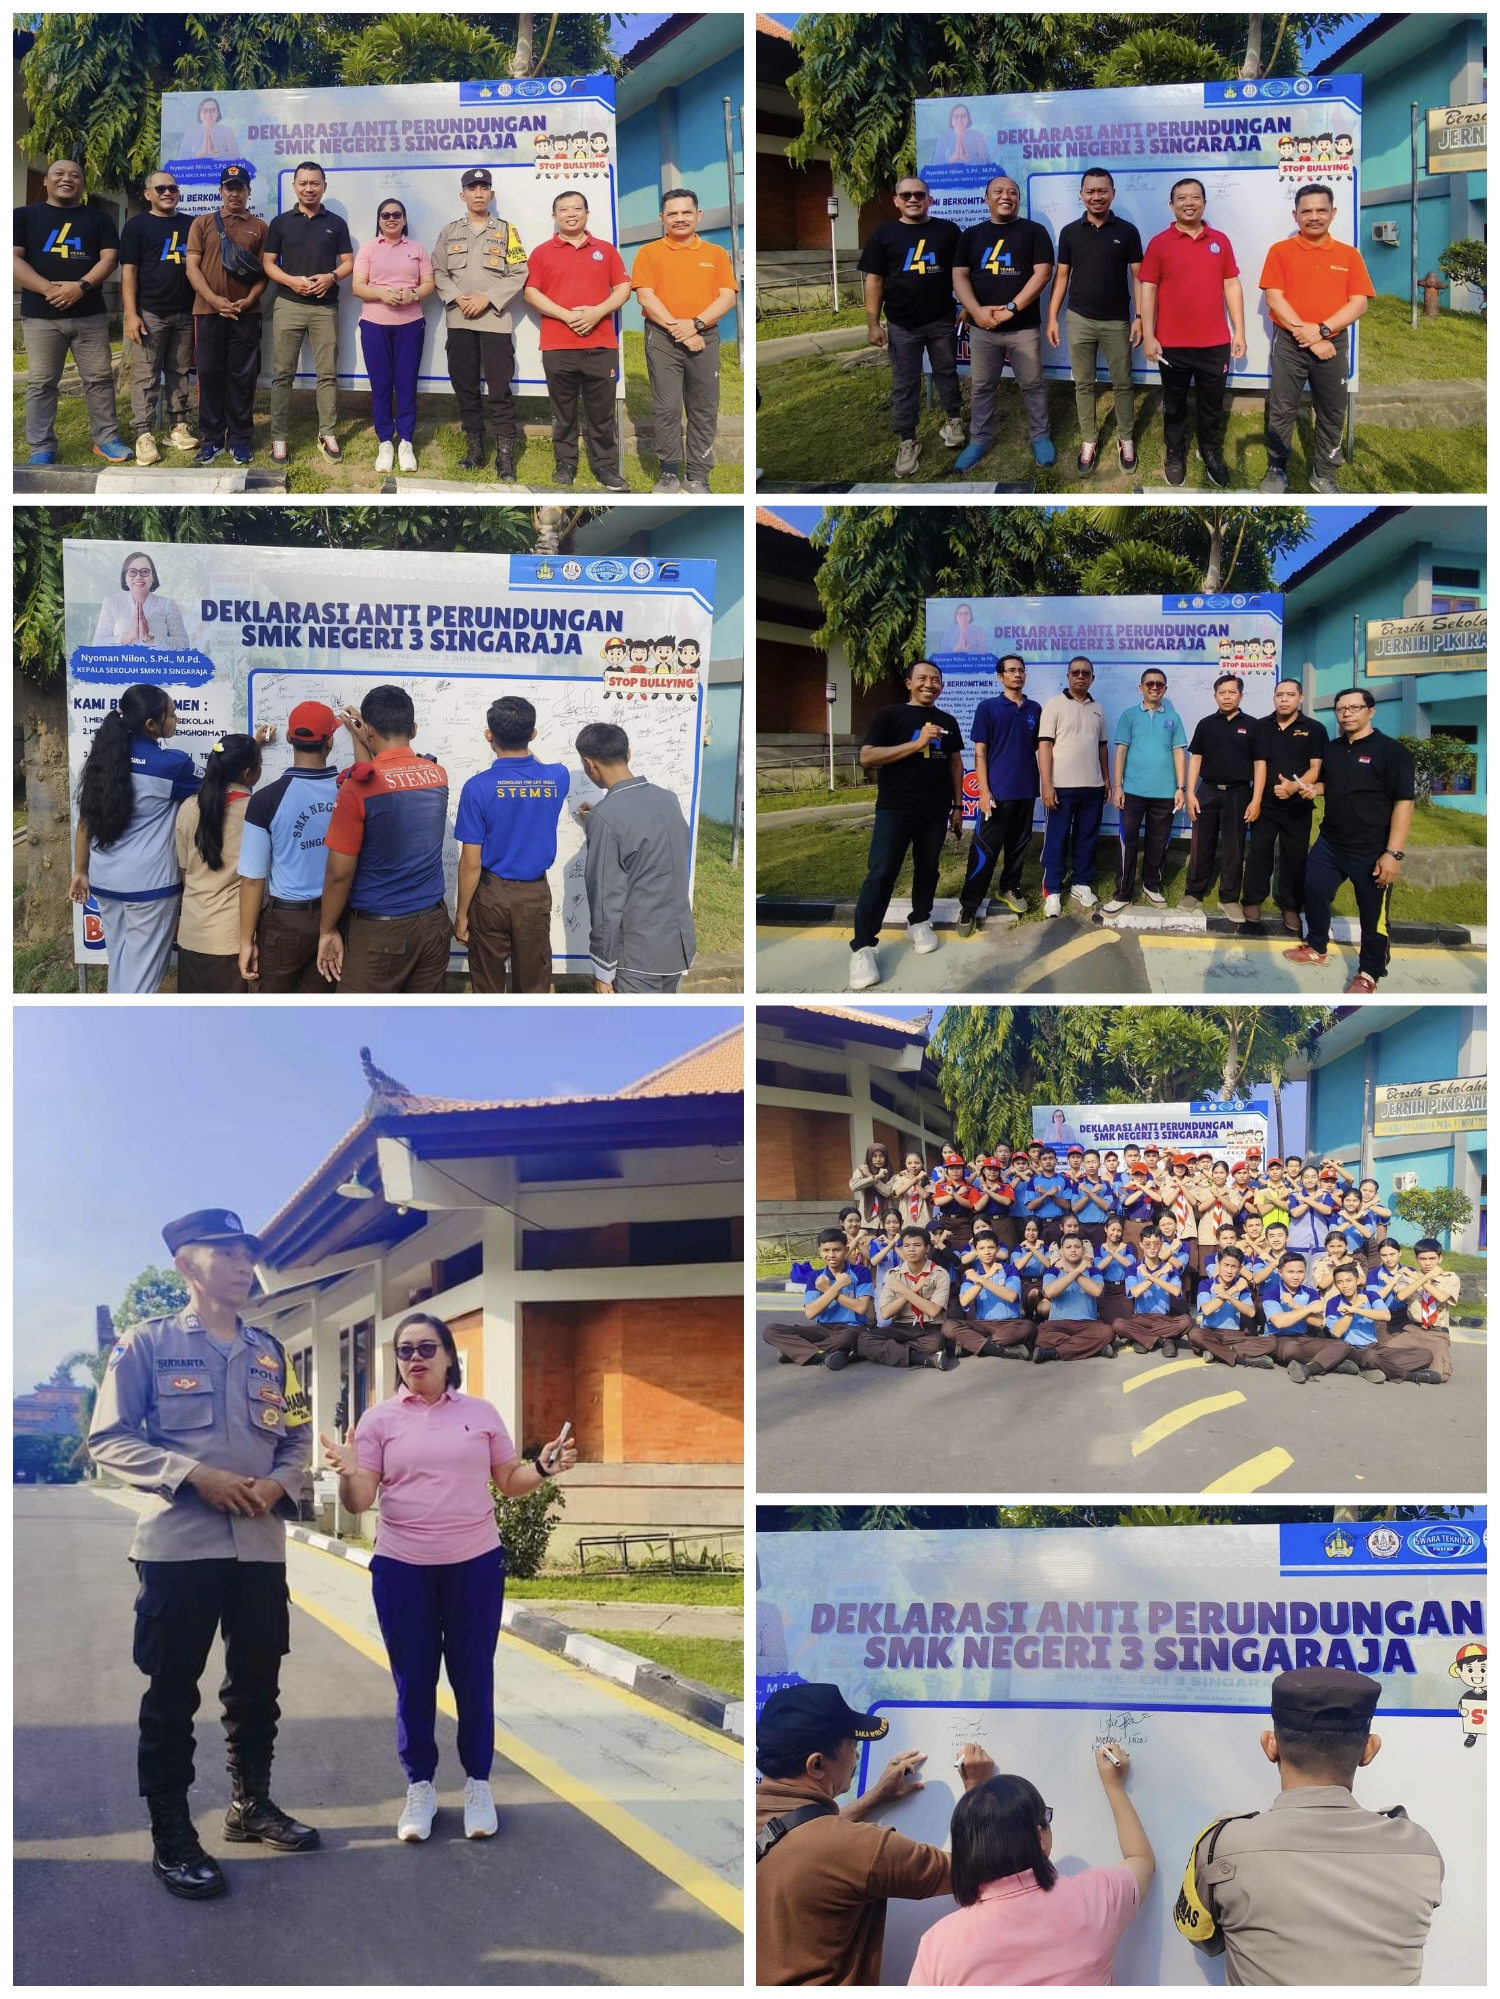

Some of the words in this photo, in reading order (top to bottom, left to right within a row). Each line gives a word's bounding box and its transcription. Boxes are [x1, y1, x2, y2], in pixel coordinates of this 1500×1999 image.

[248, 121, 349, 140] DEKLARASI
[352, 120, 397, 137] ANTI
[401, 115, 547, 136] PERUNDUNGAN
[997, 125, 1093, 145] DEKLARASI
[1097, 123, 1142, 140] ANTI
[1146, 116, 1291, 138] PERUNDUNGAN
[274, 139, 316, 155] SMK
[320, 137, 386, 154] NEGERI
[390, 136, 401, 152] 3
[404, 133, 518, 152] SINGARAJA
[1023, 143, 1063, 160] SMK
[1066, 140, 1131, 158] NEGERI
[1135, 139, 1145, 155] 3
[1150, 135, 1262, 154] SINGARAJA
[539, 162, 561, 170] STOP
[563, 161, 606, 170] BULLYING
[1282, 164, 1305, 172] STOP
[1306, 163, 1350, 172] BULLYING
[943, 197, 986, 206] BERKOMITM
[201, 599, 350, 625] DEKLARASI
[355, 603, 421, 627] ANTI
[426, 604, 624, 632] PERUNDUNGAN
[994, 625, 1074, 639] DEKLARASI
[1077, 624, 1113, 638] ANTI
[1116, 623, 1230, 637] PERUNDUNGAN
[1381, 620, 1425, 636] Bersih
[241, 625, 302, 648] SMK
[308, 626, 404, 650] NEGERI
[409, 628, 424, 651] 3
[430, 629, 583, 656] SINGARAJA
[1015, 638, 1048, 651] SMK
[1050, 638, 1103, 651] NEGERI
[1106, 637, 1115, 650] 3
[1118, 637, 1206, 651] SINGARAJA
[1375, 634, 1430, 656] JERNIH
[81, 653, 119, 665] Nyoman
[121, 654, 148, 664] Nilon,
[150, 655, 175, 665] S.Pd.,
[176, 655, 201, 664] M.Pd.
[1240, 661, 1273, 669] BULLYING
[77, 666, 104, 674] KEPALA
[140, 667, 161, 675] SMKN
[169, 668, 208, 676] SINGARAJA
[608, 676, 639, 687] STOP
[640, 677, 694, 689] BULLYING
[946, 680, 993, 688] BERKOMITMEN
[73, 698, 105, 710] KAMI
[174, 729, 227, 737] ENGHORMATI
[383, 768, 443, 789] STEMSI
[496, 787, 558, 798] STEMSI
[292, 811, 310, 839] SMK
[309, 802, 333, 815] NEG
[1386, 1086, 1423, 1100] Bersih
[1381, 1099, 1426, 1119] JERNIH
[1079, 1123, 1133, 1133] DEKLARASI
[1135, 1122, 1158, 1132] ANTI
[1160, 1120, 1234, 1131] PERUNDUNGAN
[1093, 1132, 1116, 1142] SMK
[1117, 1131, 1152, 1141] NEGERI
[1154, 1131, 1160, 1140] 3
[1161, 1130, 1218, 1140] SINGARAJA
[158, 1358, 206, 1369] SUDIARTA
[1415, 1535, 1441, 1545] SWARA
[1442, 1534, 1473, 1545] TEKNIKA
[810, 1601, 1028, 1635] DEKLARASI
[1035, 1600, 1140, 1635] ANTI
[1148, 1600, 1486, 1636] PERUNDUNGAN
[863, 1636, 955, 1670] SMK
[962, 1635, 1112, 1670] NEGERI
[1119, 1636, 1144, 1671] 3
[1154, 1636, 1418, 1674] SINGARAJA
[854, 1729, 870, 1738] SAKA
